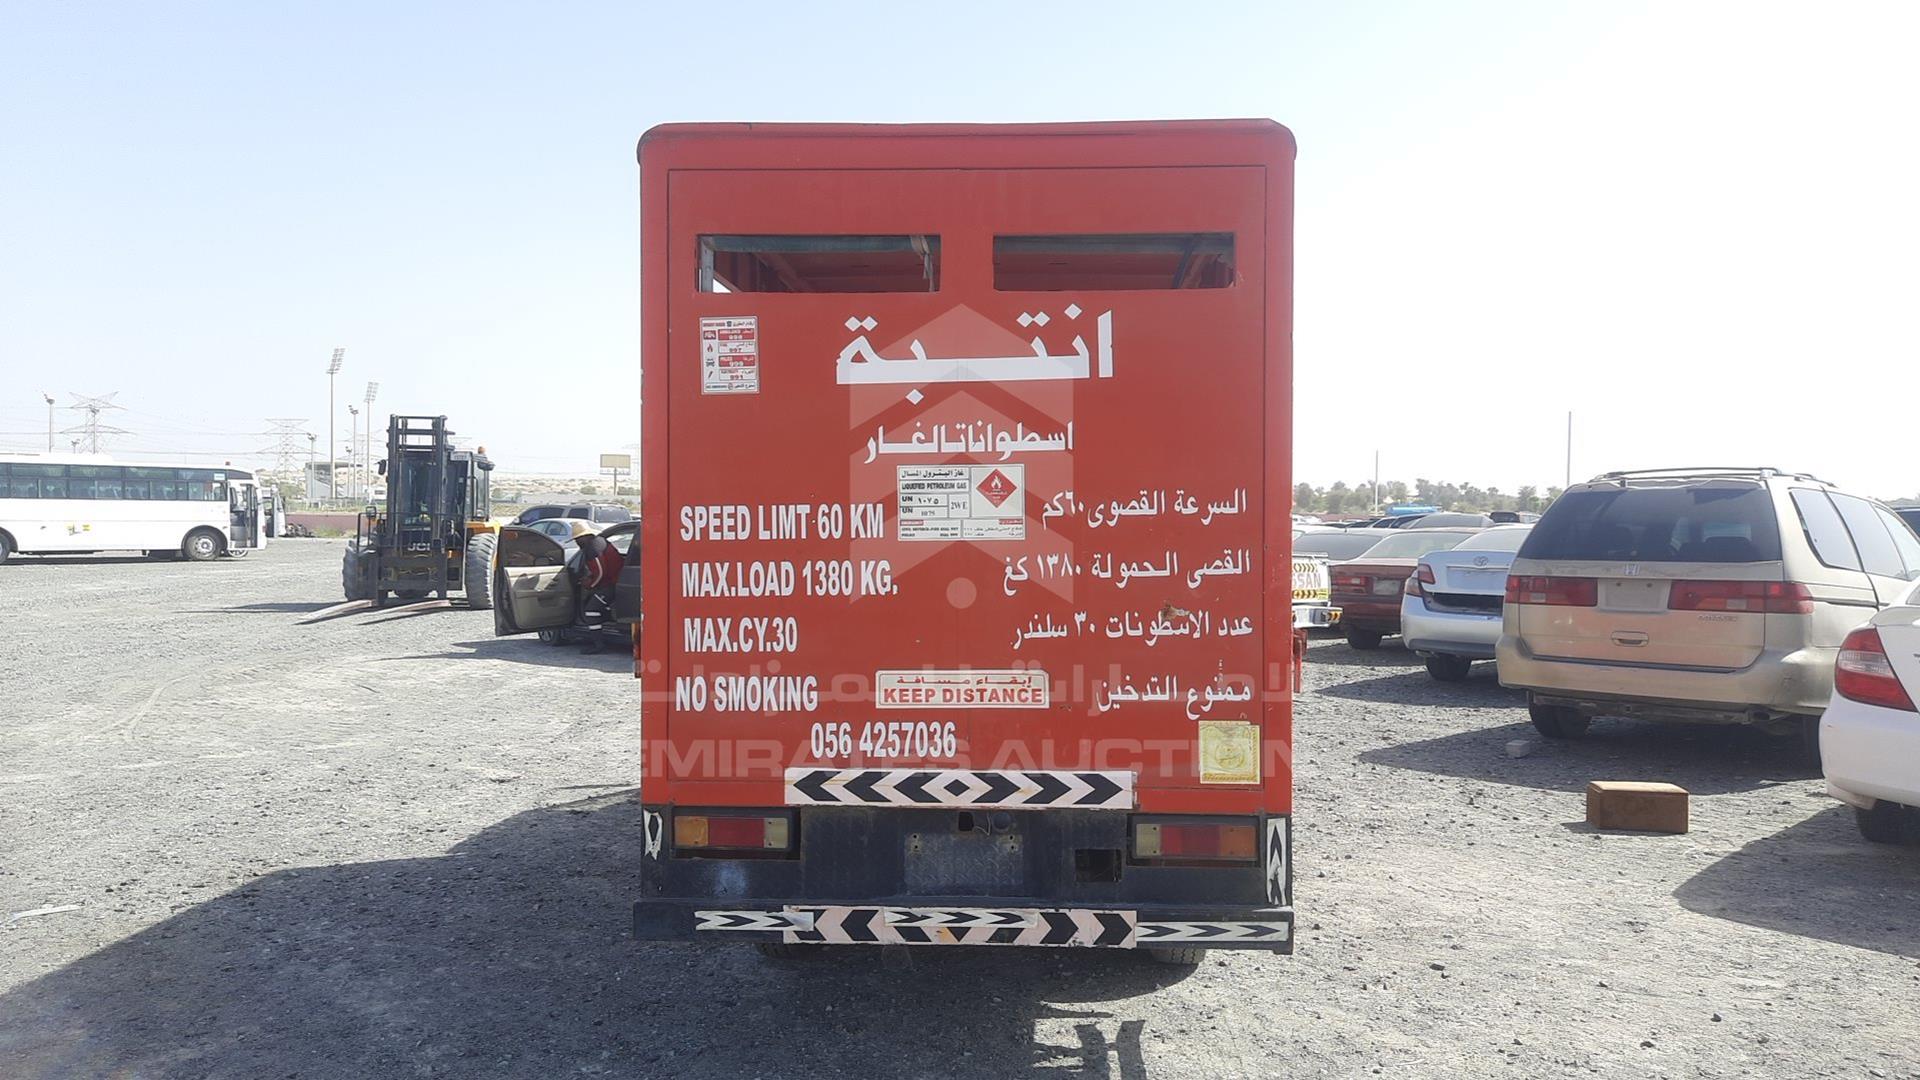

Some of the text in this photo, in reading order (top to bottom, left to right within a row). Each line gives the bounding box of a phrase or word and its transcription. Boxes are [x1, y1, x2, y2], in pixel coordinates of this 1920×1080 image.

[836, 303, 1113, 405] انتبة
[680, 503, 884, 541] SPEED LIMT 60 KM
[1173, 488, 1247, 526] السرعة
[408, 543, 430, 551] JC
[682, 560, 898, 598] MAX.LOAD 1380 KG.
[684, 617, 798, 653] MAX.CY.30
[1010, 613, 1068, 649] سلندر
[1217, 615, 1253, 637] عدد
[675, 675, 819, 712] NO SMOKING
[883, 687, 1043, 703] KEEP DISTANCE
[1096, 675, 1252, 721] ممنوع التدخين
[811, 720, 957, 758] 056 4257036
